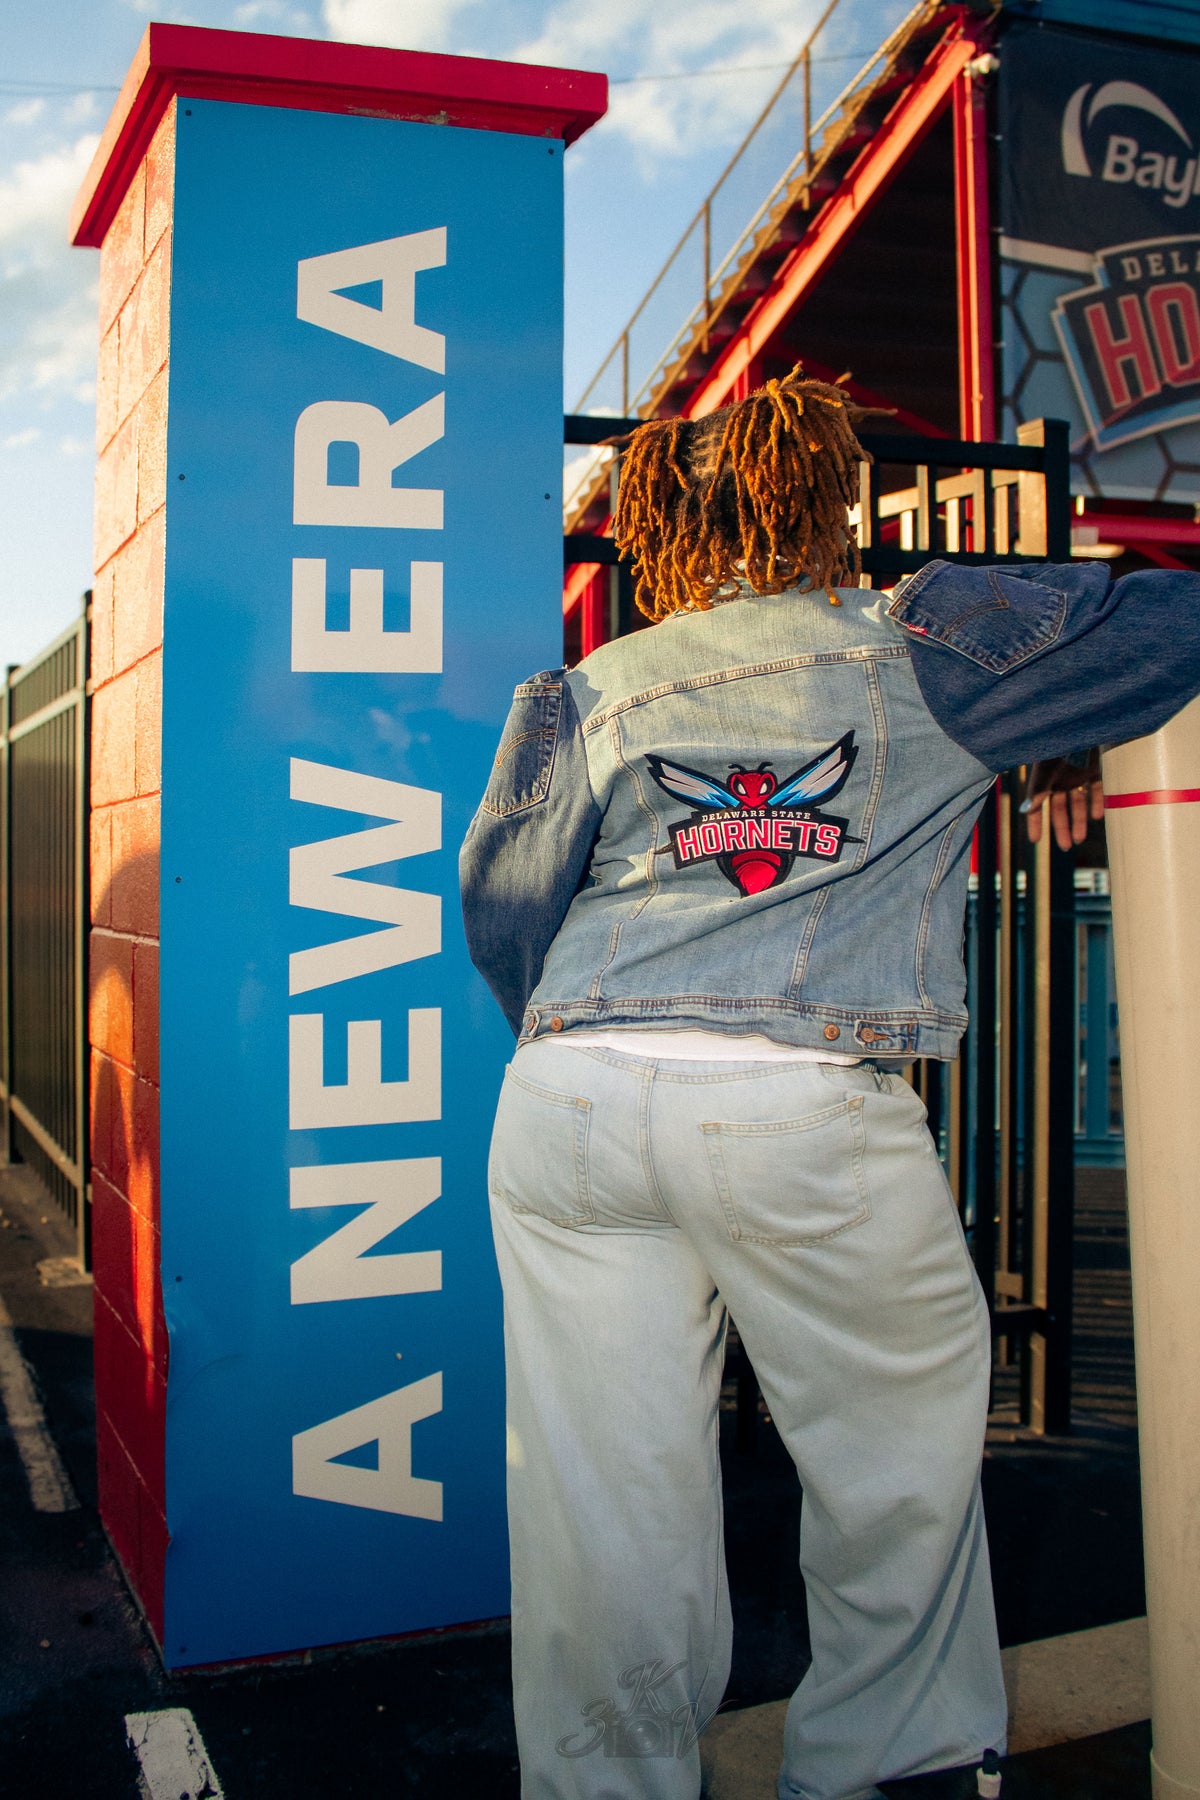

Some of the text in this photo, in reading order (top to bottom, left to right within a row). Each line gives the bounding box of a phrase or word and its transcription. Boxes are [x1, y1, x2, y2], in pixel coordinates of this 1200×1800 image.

[1103, 134, 1200, 208] Bay
[1120, 250, 1200, 282] DEL
[701, 810, 812, 822] DELAWARE STATE
[675, 818, 841, 862] HORNETS
[289, 226, 447, 1521] A NEW ERA
